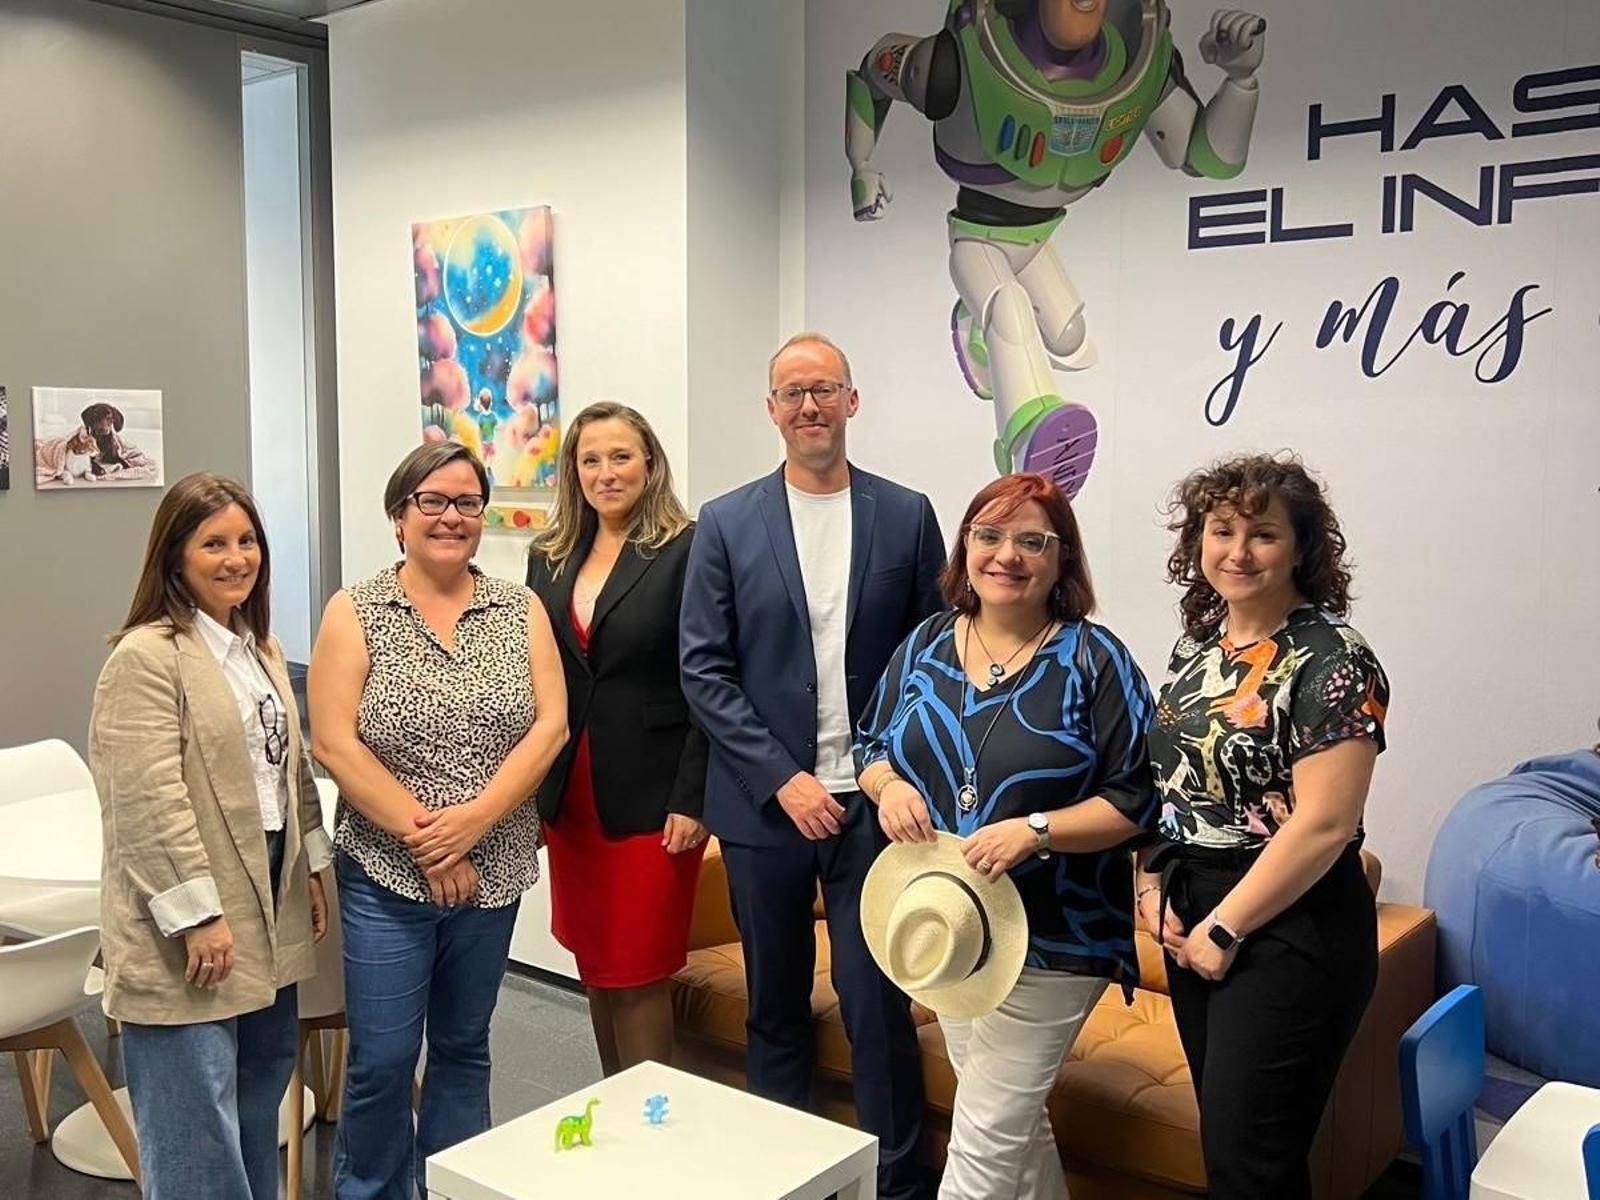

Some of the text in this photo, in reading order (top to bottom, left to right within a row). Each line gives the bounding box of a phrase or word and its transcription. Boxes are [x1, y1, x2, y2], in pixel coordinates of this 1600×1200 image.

[1307, 65, 1600, 160] HAS
[1187, 153, 1600, 250] EL INF
[1204, 271, 1553, 427] y más
